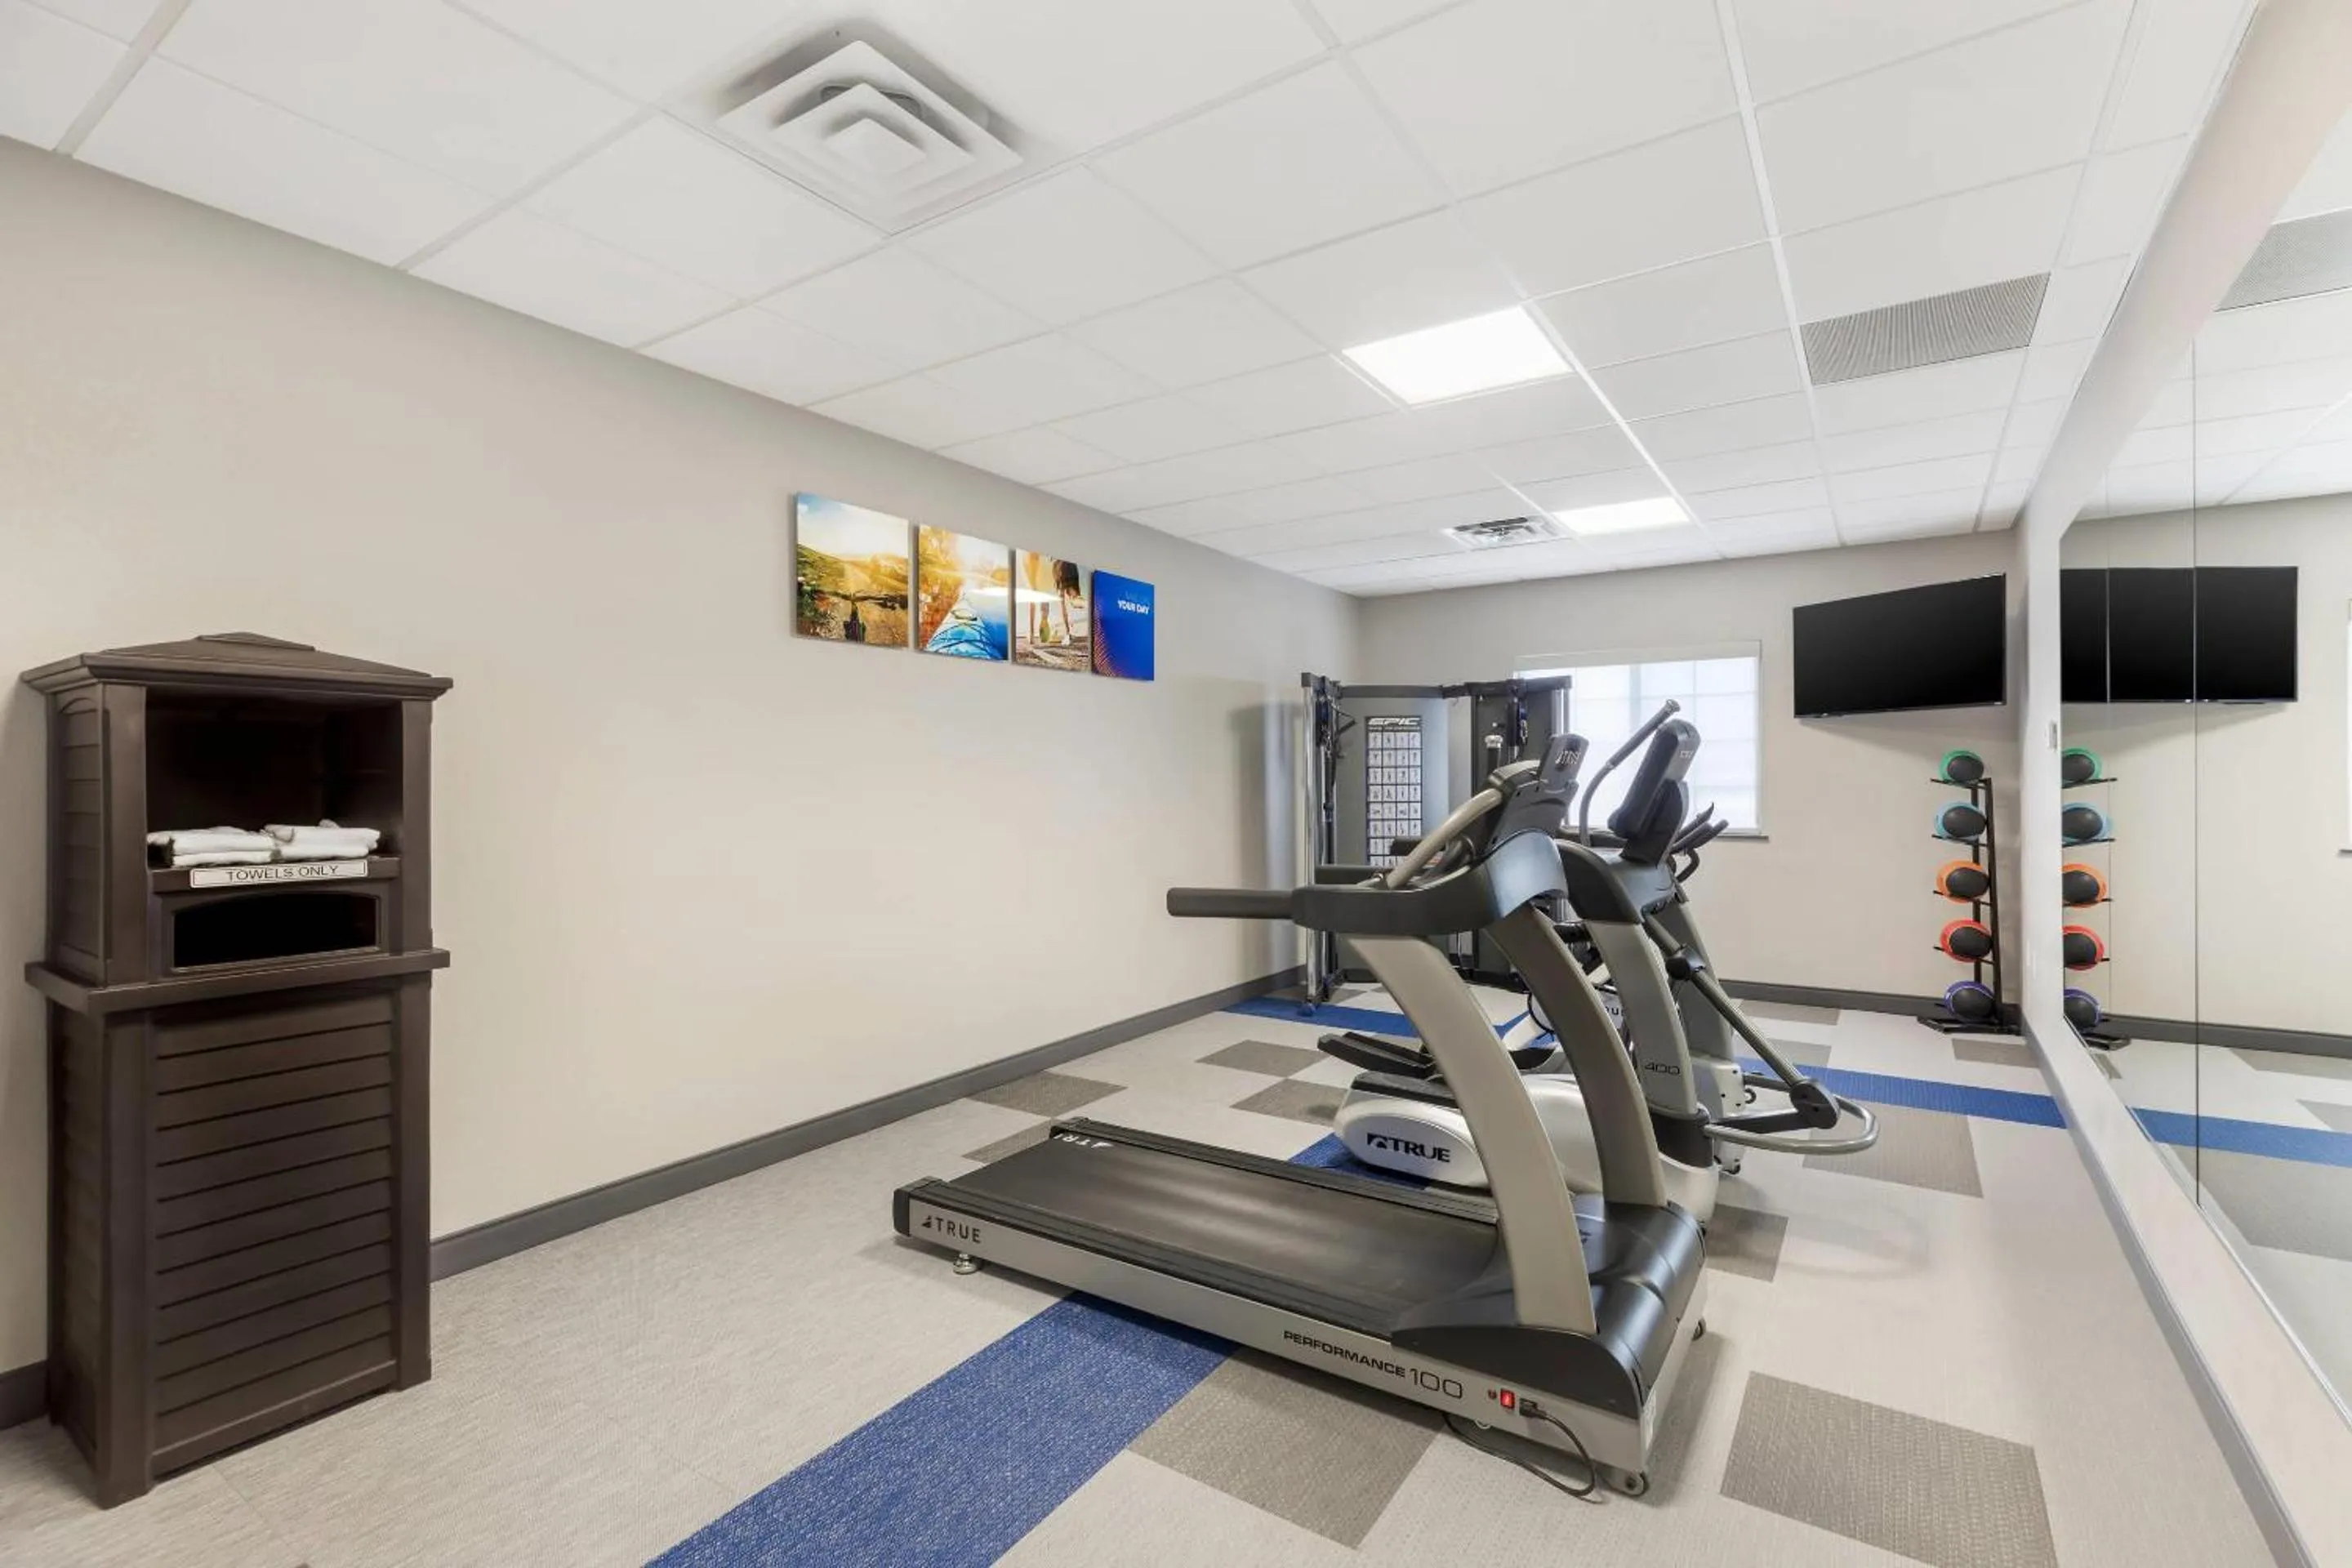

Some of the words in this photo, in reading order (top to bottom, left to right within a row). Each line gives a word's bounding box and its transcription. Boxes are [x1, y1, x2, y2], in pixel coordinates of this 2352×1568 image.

[1117, 599, 1136, 612] YOUR
[1136, 604, 1150, 615] DAY
[1368, 717, 1420, 726] EPIC
[226, 867, 294, 883] TOWELS
[298, 864, 339, 879] ONLY
[1644, 1061, 1680, 1076] 400
[1392, 1137, 1451, 1163] TRUE
[935, 1218, 982, 1244] TRUE
[1283, 1330, 1406, 1379] PERFORMANCE
[1410, 1368, 1464, 1401] 100
